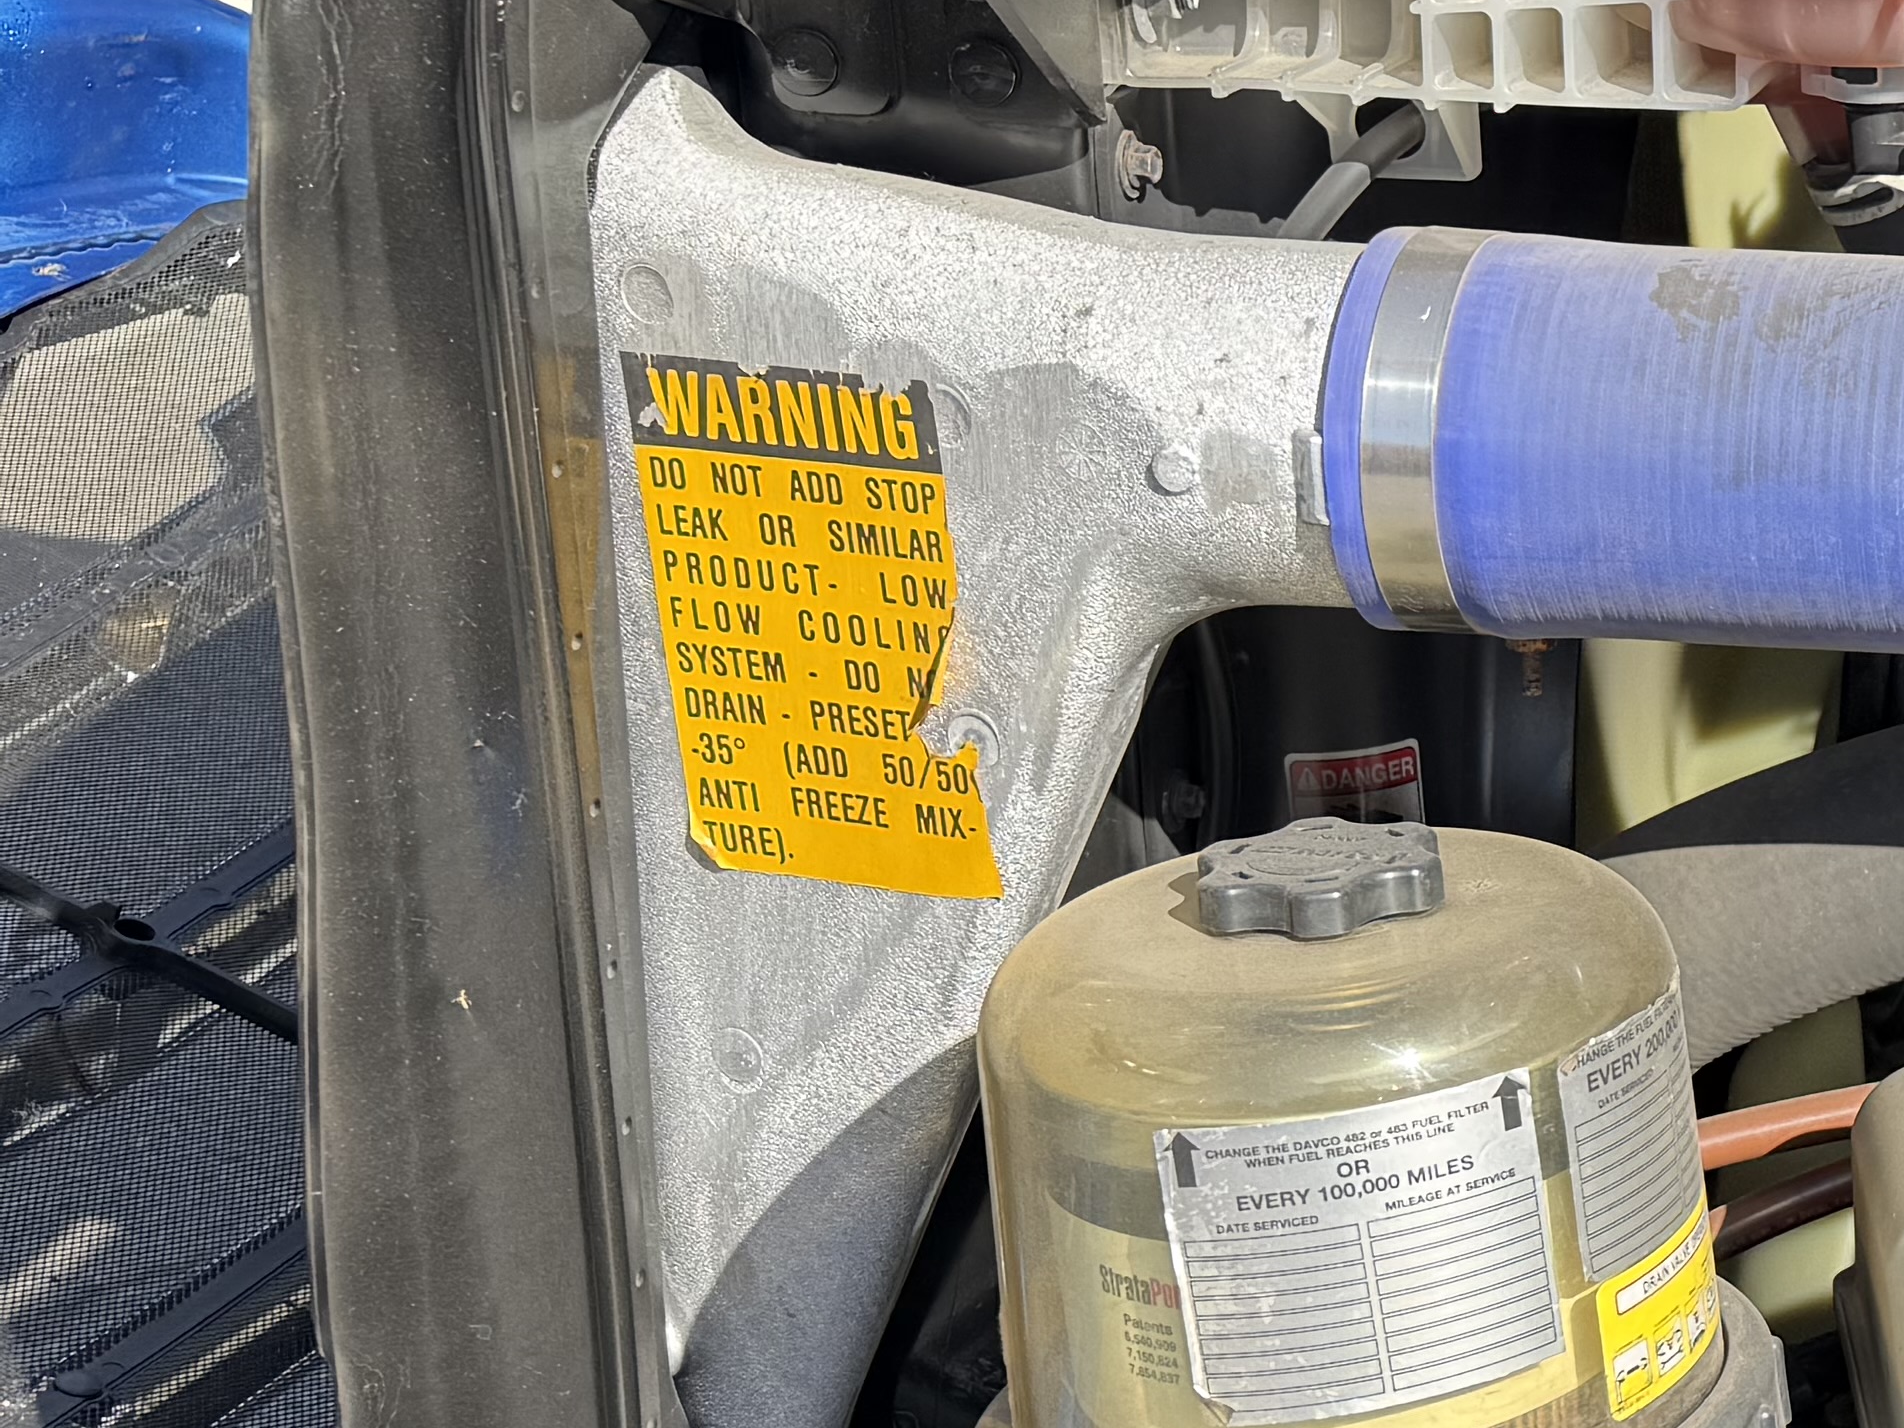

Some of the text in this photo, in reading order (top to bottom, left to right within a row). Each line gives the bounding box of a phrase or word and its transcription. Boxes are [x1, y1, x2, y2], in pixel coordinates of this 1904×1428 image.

[646, 365, 922, 461] WARNING
[649, 456, 937, 516] DO NOT ADD STOP
[656, 504, 944, 564] LEAK OR SIMILAR
[663, 549, 947, 610] PRODUCT- LOW
[670, 596, 761, 637] FLOW
[676, 641, 881, 694] SYSTEM DO
[684, 687, 912, 743] DRAIN PRESET
[783, 740, 848, 779] (ADD
[883, 752, 973, 796] 50/50
[1322, 756, 1415, 790] DANGER
[699, 777, 978, 840] ANTI FREEZE MIX-
[702, 819, 795, 864] TURE).
[1571, 1016, 1653, 1071] HANGE THE FUEL
[1586, 1044, 1641, 1092] EVERY
[1205, 1144, 1261, 1160] CHANGE
[1264, 1142, 1290, 1154] THE
[1293, 1136, 1340, 1151] DAVCO
[1344, 1131, 1367, 1145] 482
[1370, 1129, 1383, 1140] or
[1411, 1114, 1443, 1129] FUEL
[1447, 1101, 1489, 1121] FILTER
[1244, 1123, 1455, 1169] WHEN FUEL REACHES THIS LINE
[1236, 1155, 1475, 1212] EVERY 100,000 MILES
[1336, 1158, 1371, 1178] OR
[1384, 1167, 1516, 1213] MILEAGE AT SERVICE
[1216, 1215, 1319, 1235] DATE SERVICED
[1643, 1264, 1669, 1295] DRAIN
[1123, 1313, 1173, 1336] Patents
